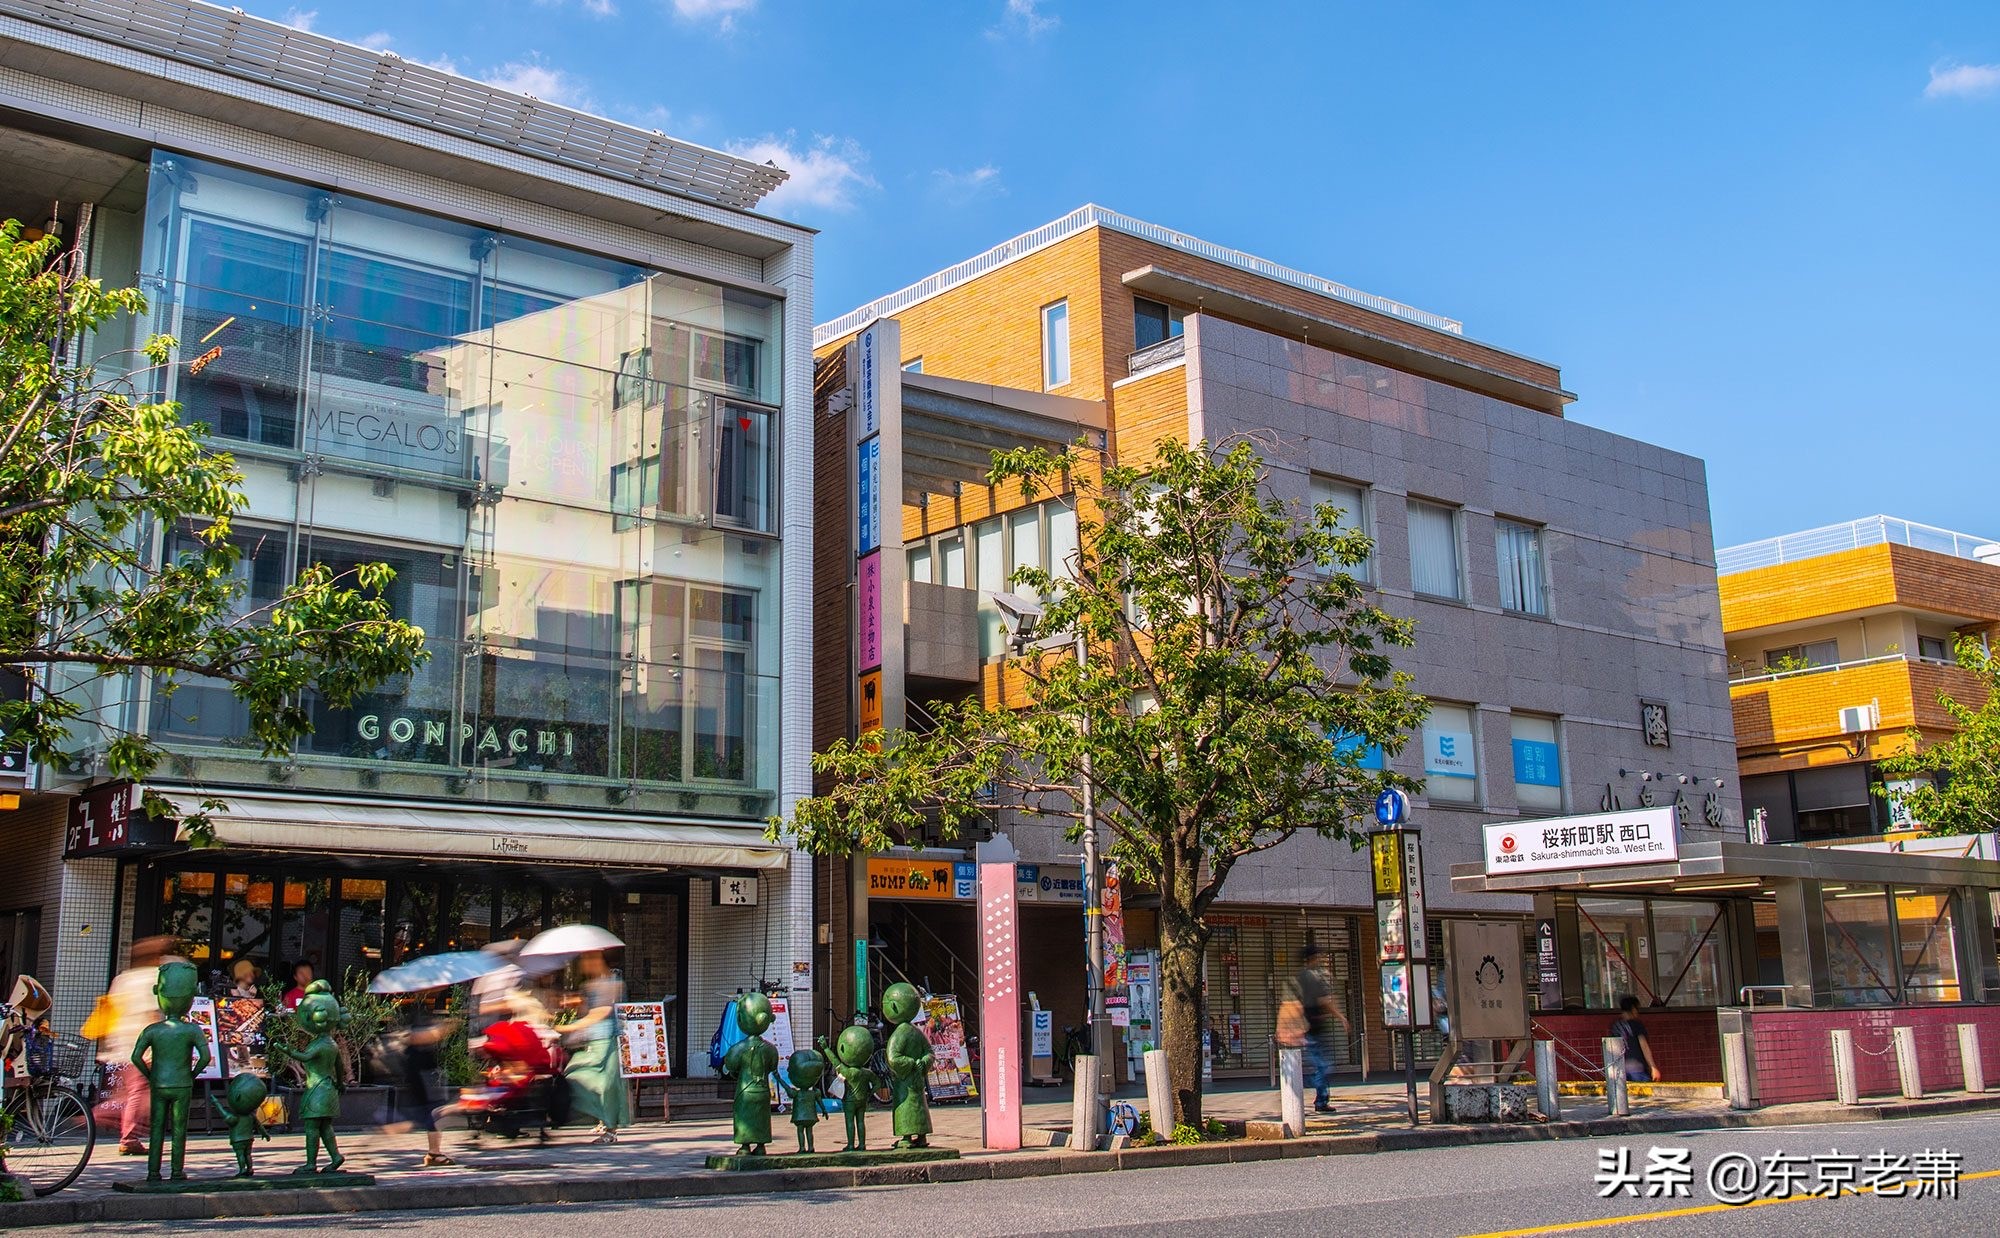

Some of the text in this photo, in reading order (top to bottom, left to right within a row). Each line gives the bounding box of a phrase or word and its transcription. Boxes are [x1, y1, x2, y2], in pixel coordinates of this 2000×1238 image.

[307, 407, 457, 454] MEGALOS
[358, 714, 573, 755] GONPACHI
[1383, 795, 1393, 820] 1
[68, 826, 82, 850] 2F
[1542, 824, 1650, 848] 桜新町駅 西口
[1495, 854, 1525, 864] 東急電鉄
[1531, 842, 1665, 861] Sakura-shimmachi Sta. West Ent.
[870, 874, 906, 889] RUMP
